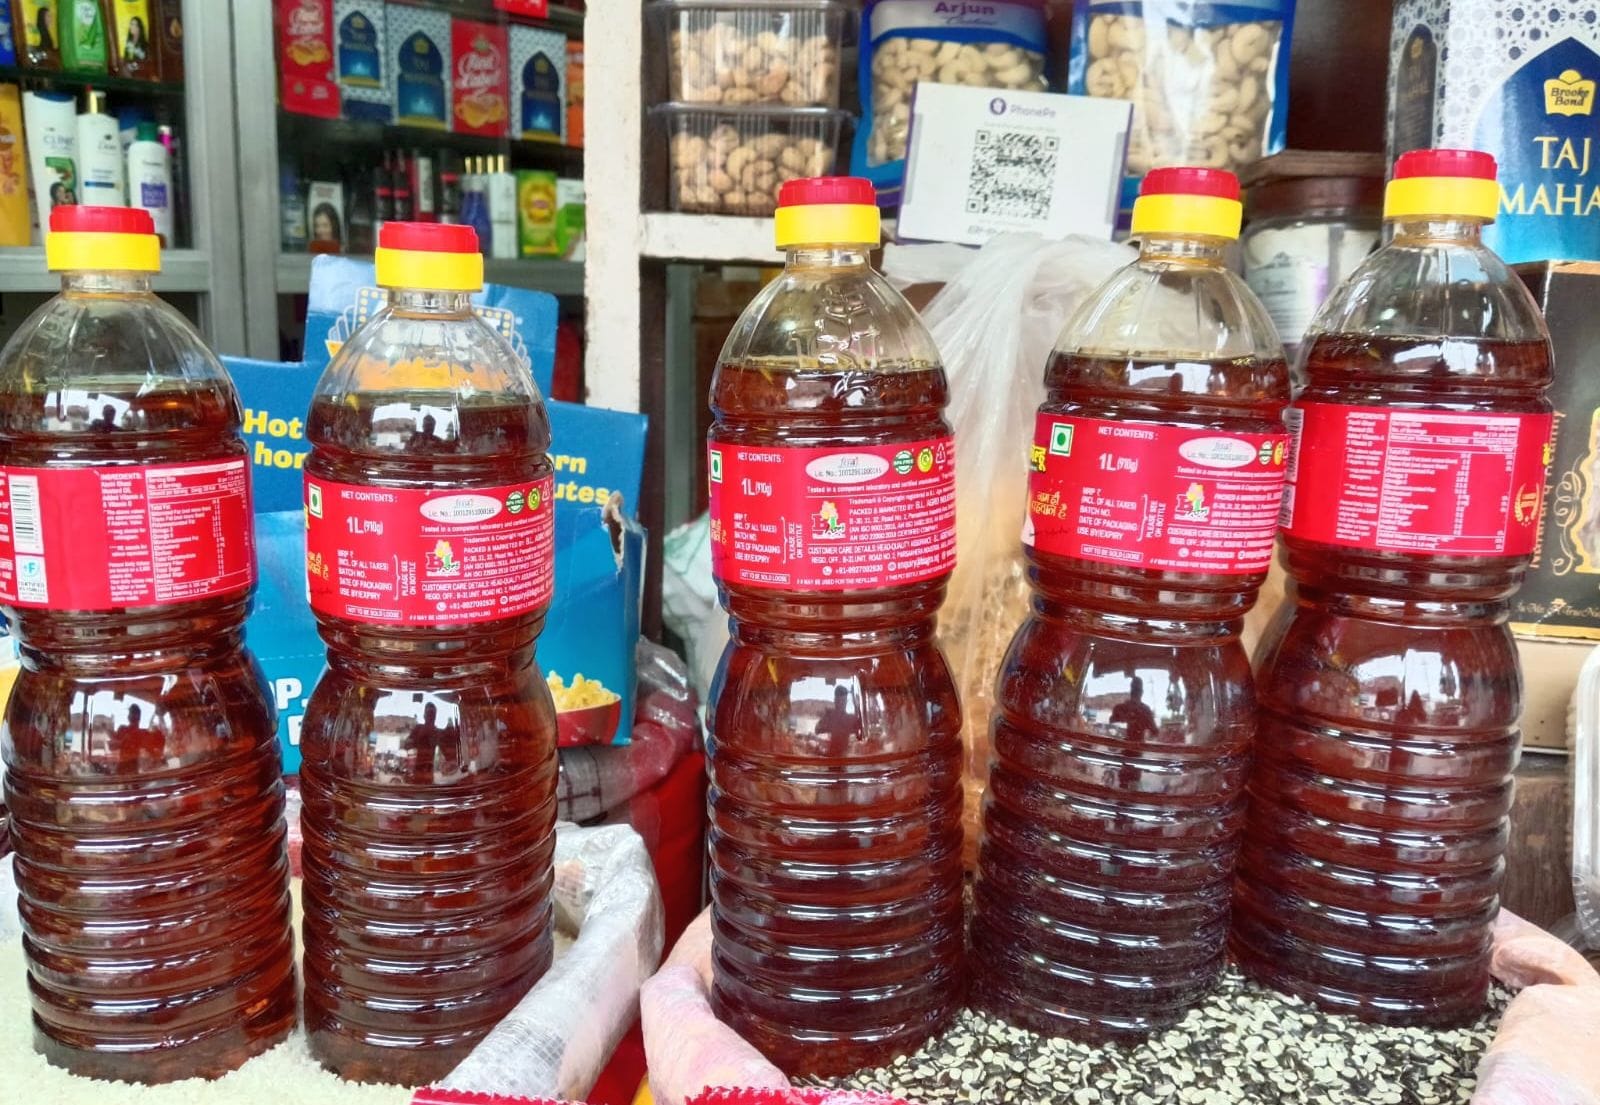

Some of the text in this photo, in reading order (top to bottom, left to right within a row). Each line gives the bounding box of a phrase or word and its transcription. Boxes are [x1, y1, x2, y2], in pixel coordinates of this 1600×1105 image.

[934, 2, 995, 14] Arjun
[1551, 88, 1590, 98] Brooke
[1555, 97, 1585, 107] Bond
[1011, 104, 1056, 117] PhonePe
[1533, 136, 1592, 176] TAJ
[243, 408, 304, 440] Hot
[1098, 426, 1154, 440] NET CONTENTS
[737, 452, 782, 463] NET CONTENTS
[1099, 453, 1116, 471] 1L
[742, 478, 756, 496] 1L
[1082, 487, 1095, 495] MRP
[341, 490, 394, 503] NET CONTENTS
[1096, 497, 1104, 506] OF
[1104, 498, 1115, 508] ALL
[1079, 505, 1099, 514] BATCH
[346, 516, 365, 534] 1L
[1078, 515, 1093, 525] DATE
[1093, 517, 1103, 526] OF
[1077, 526, 1089, 535] USE
[421, 583, 451, 591] CUSTOMER
